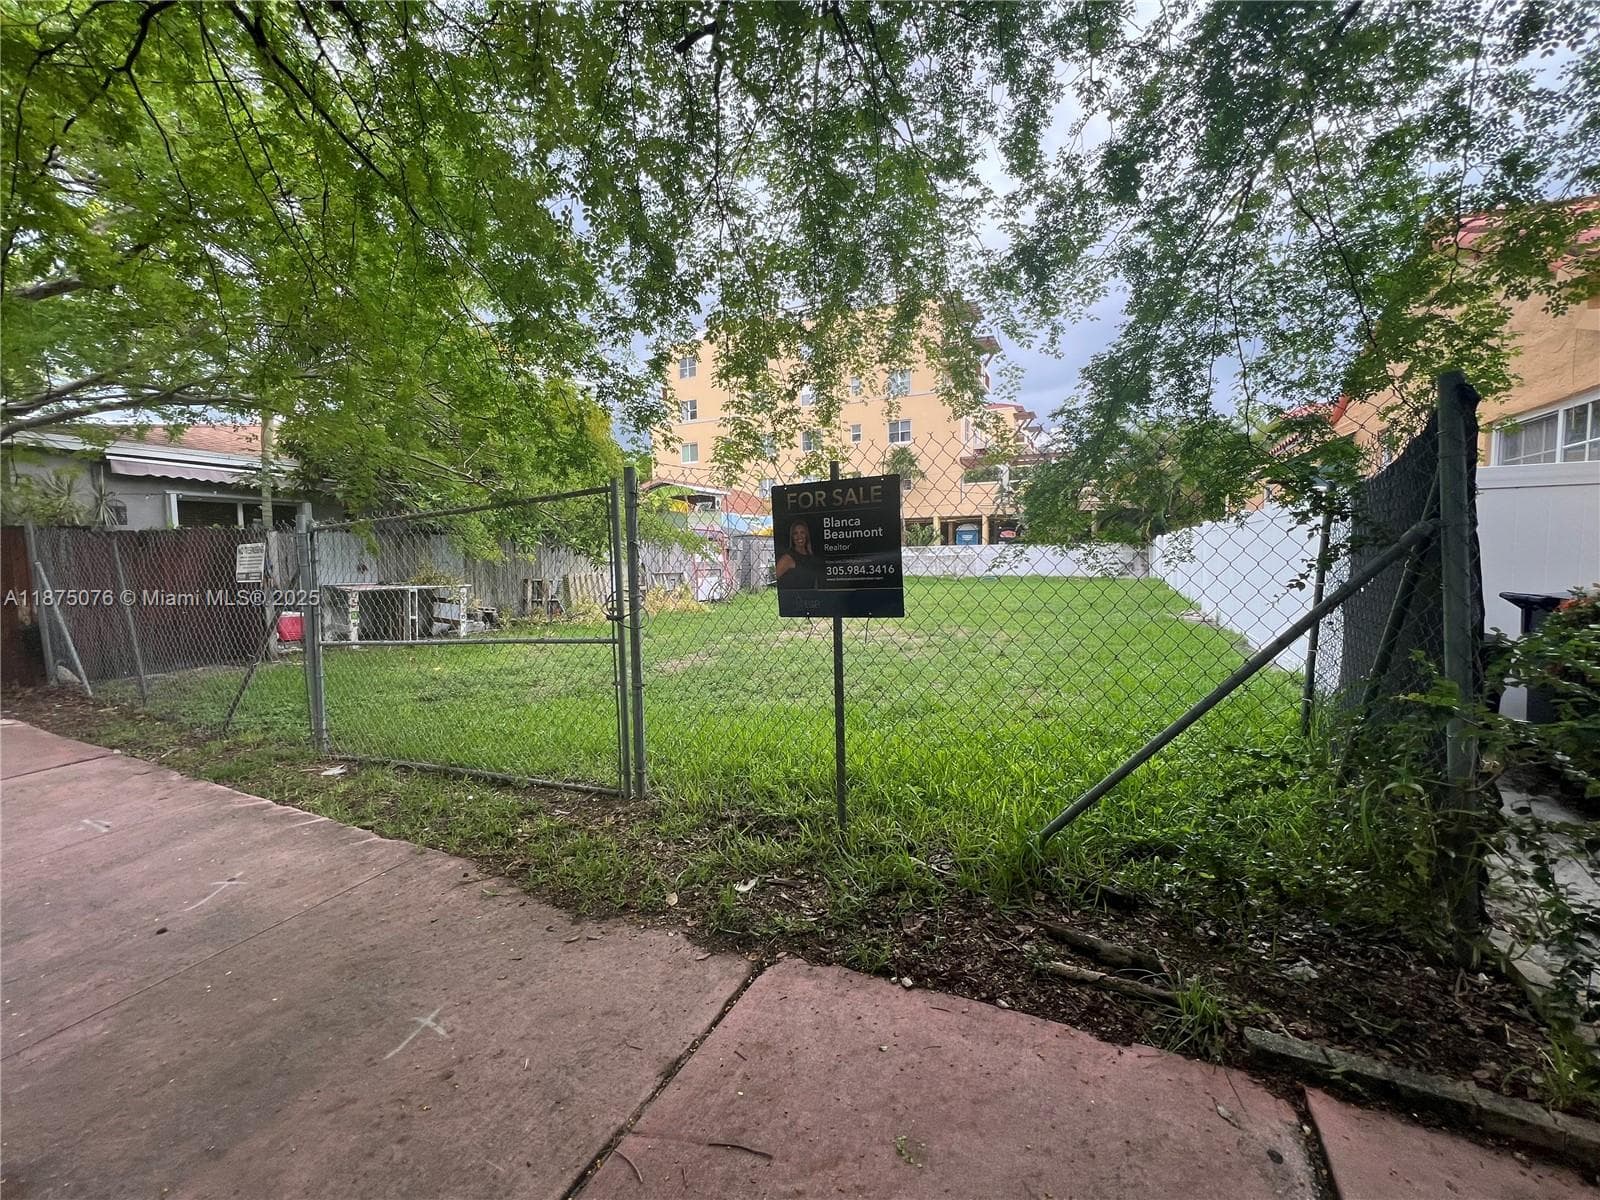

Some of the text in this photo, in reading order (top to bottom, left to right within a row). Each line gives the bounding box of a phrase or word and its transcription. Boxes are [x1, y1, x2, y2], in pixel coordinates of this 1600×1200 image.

[787, 485, 883, 510] FOR SALE
[823, 517, 861, 528] Blanca
[823, 527, 883, 540] Beaumont
[824, 543, 851, 552] Realtor
[826, 564, 895, 576] 305.984.3416
